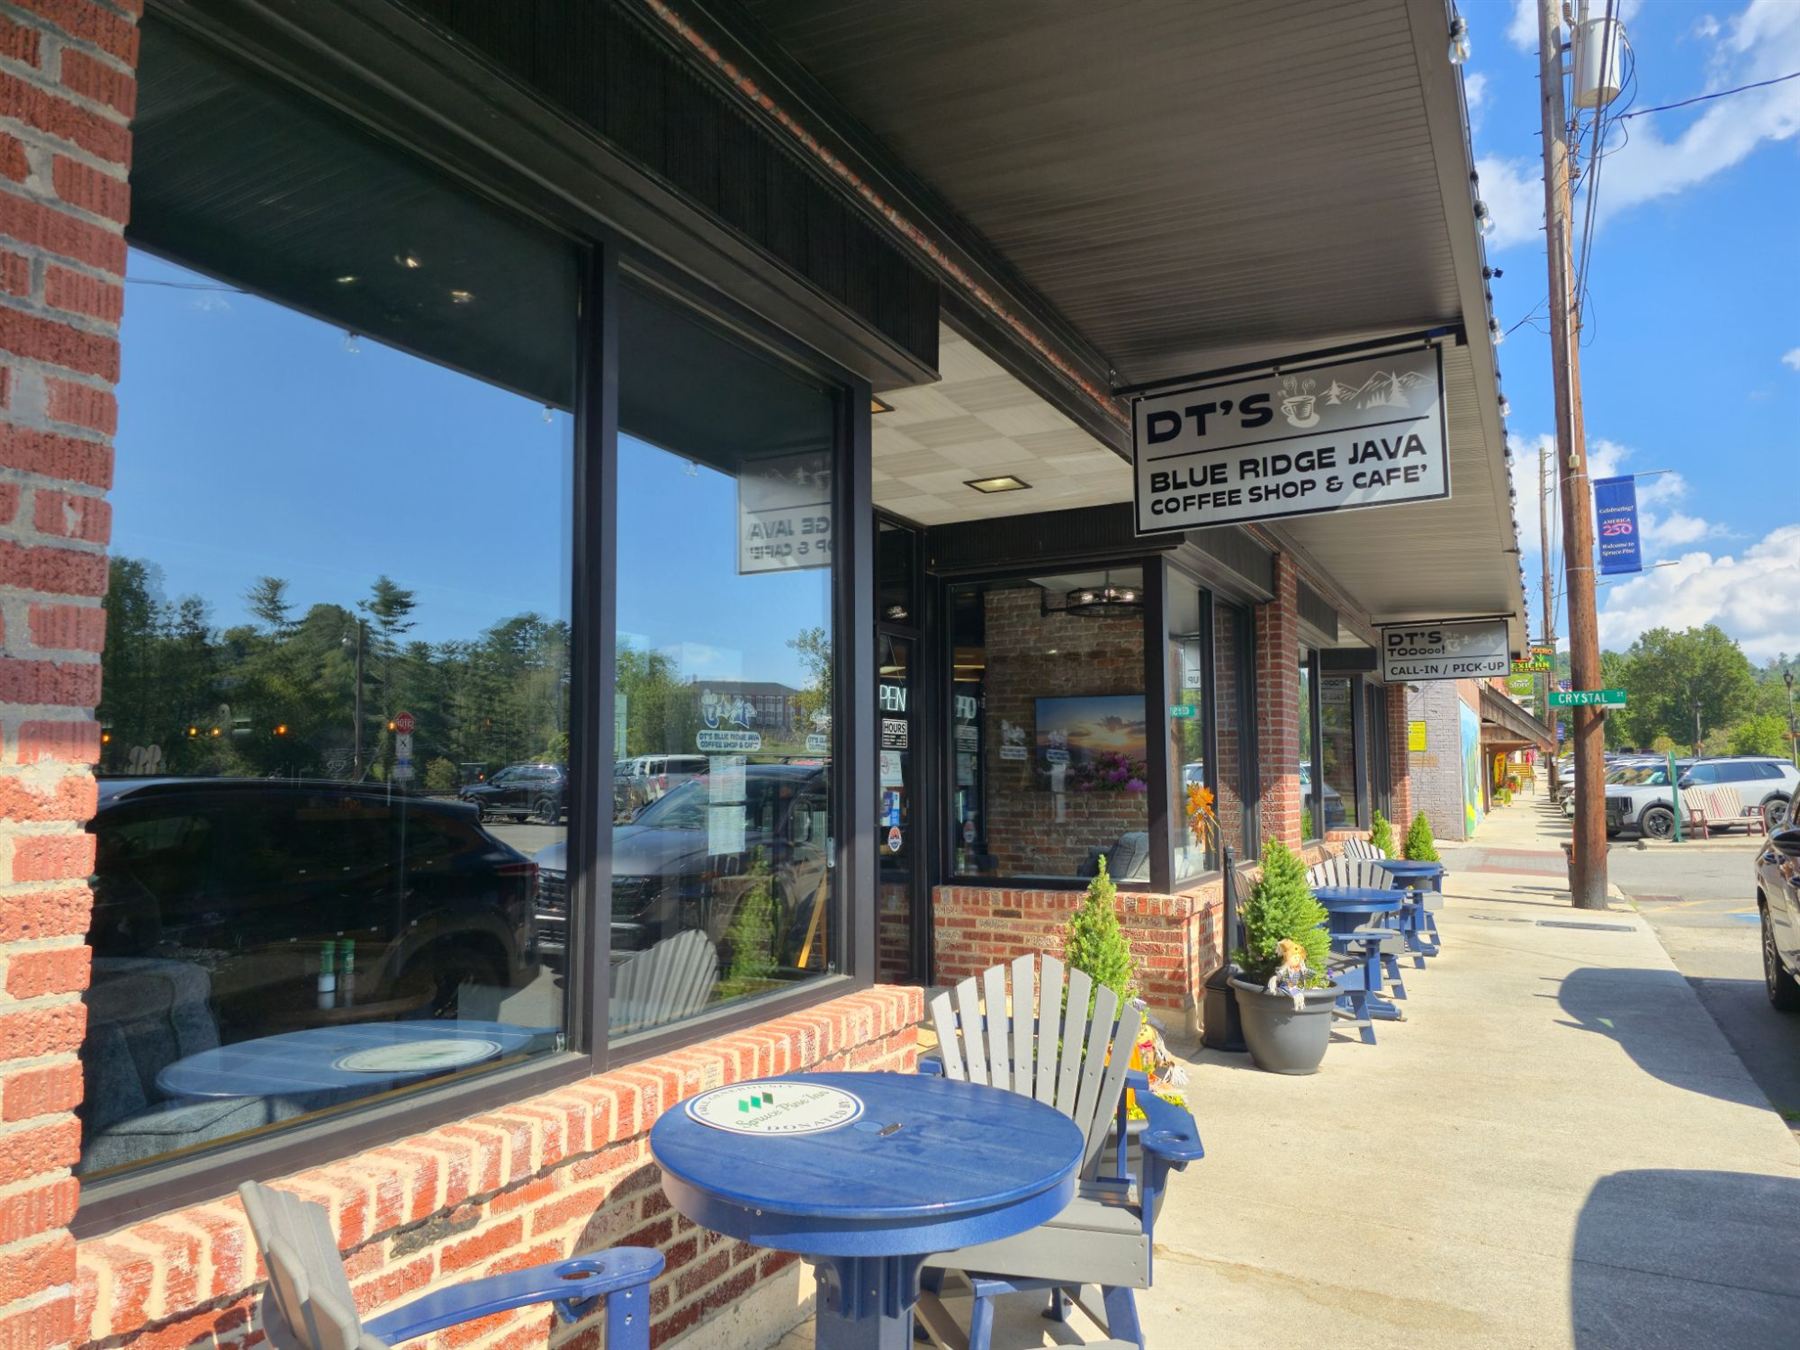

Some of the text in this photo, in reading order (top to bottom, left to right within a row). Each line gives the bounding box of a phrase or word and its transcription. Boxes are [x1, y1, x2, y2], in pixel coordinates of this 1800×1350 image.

[1147, 392, 1274, 445] DT'S
[1151, 434, 1427, 494] BLUE RIDGE JAVA
[1151, 488, 1242, 516] COFFEE
[1249, 479, 1317, 504] SHOP
[1325, 475, 1343, 493] &
[1602, 523, 1632, 536] 250
[1388, 631, 1442, 646] DT'S
[1390, 665, 1439, 676] CALL-IN
[1453, 661, 1505, 673] PICK-UP
[880, 684, 907, 711] PEN
[1558, 693, 1608, 704] CRYSTAL
[884, 723, 906, 733] HOURS
